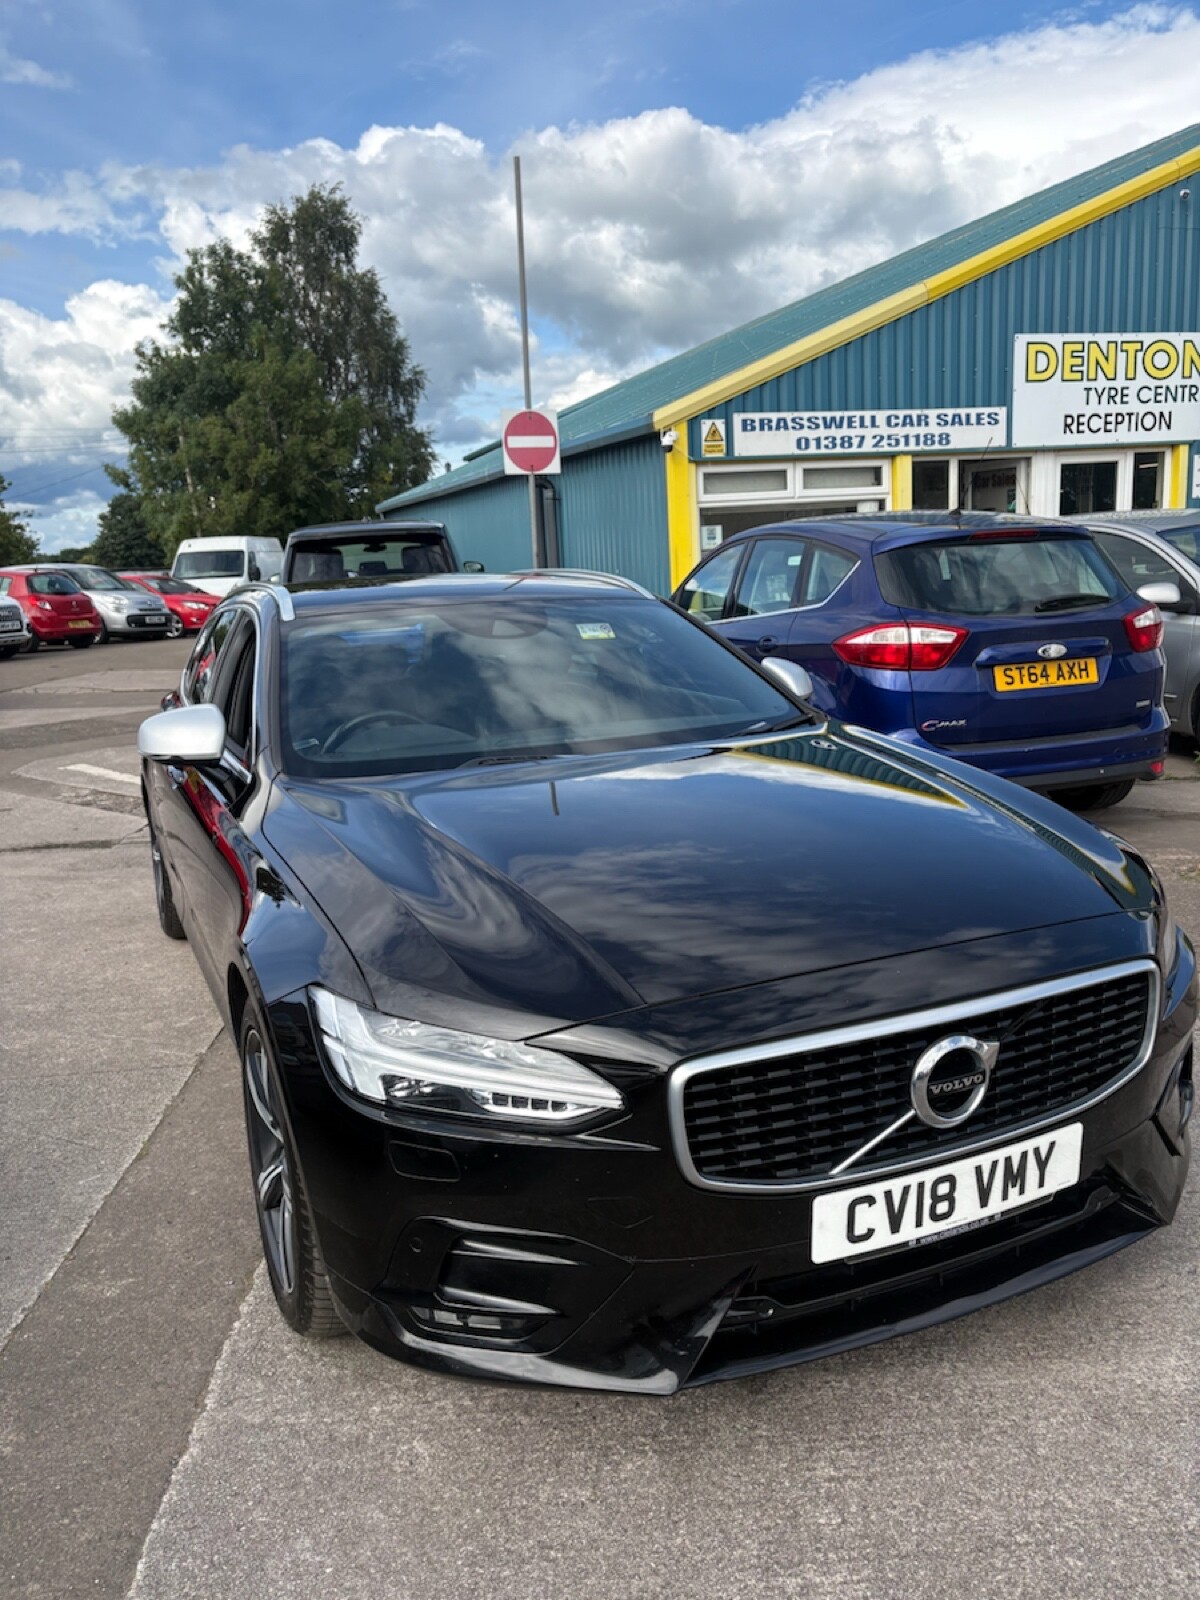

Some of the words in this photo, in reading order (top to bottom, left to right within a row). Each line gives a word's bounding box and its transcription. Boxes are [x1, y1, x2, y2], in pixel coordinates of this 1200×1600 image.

[1084, 387, 1130, 406] TYRE
[1136, 384, 1200, 404] CENTR
[740, 415, 880, 433] BRASSWELL
[886, 412, 930, 429] CAR
[936, 411, 1000, 427] SALES
[1063, 411, 1173, 435] RECEPTION
[795, 434, 866, 451] 01387
[871, 432, 951, 449] 251188
[1003, 663, 1050, 686] ST64
[1056, 660, 1090, 682] AXH
[929, 1073, 984, 1096] VOLVO
[846, 1173, 958, 1245] CV18
[974, 1140, 1057, 1210] VMY
